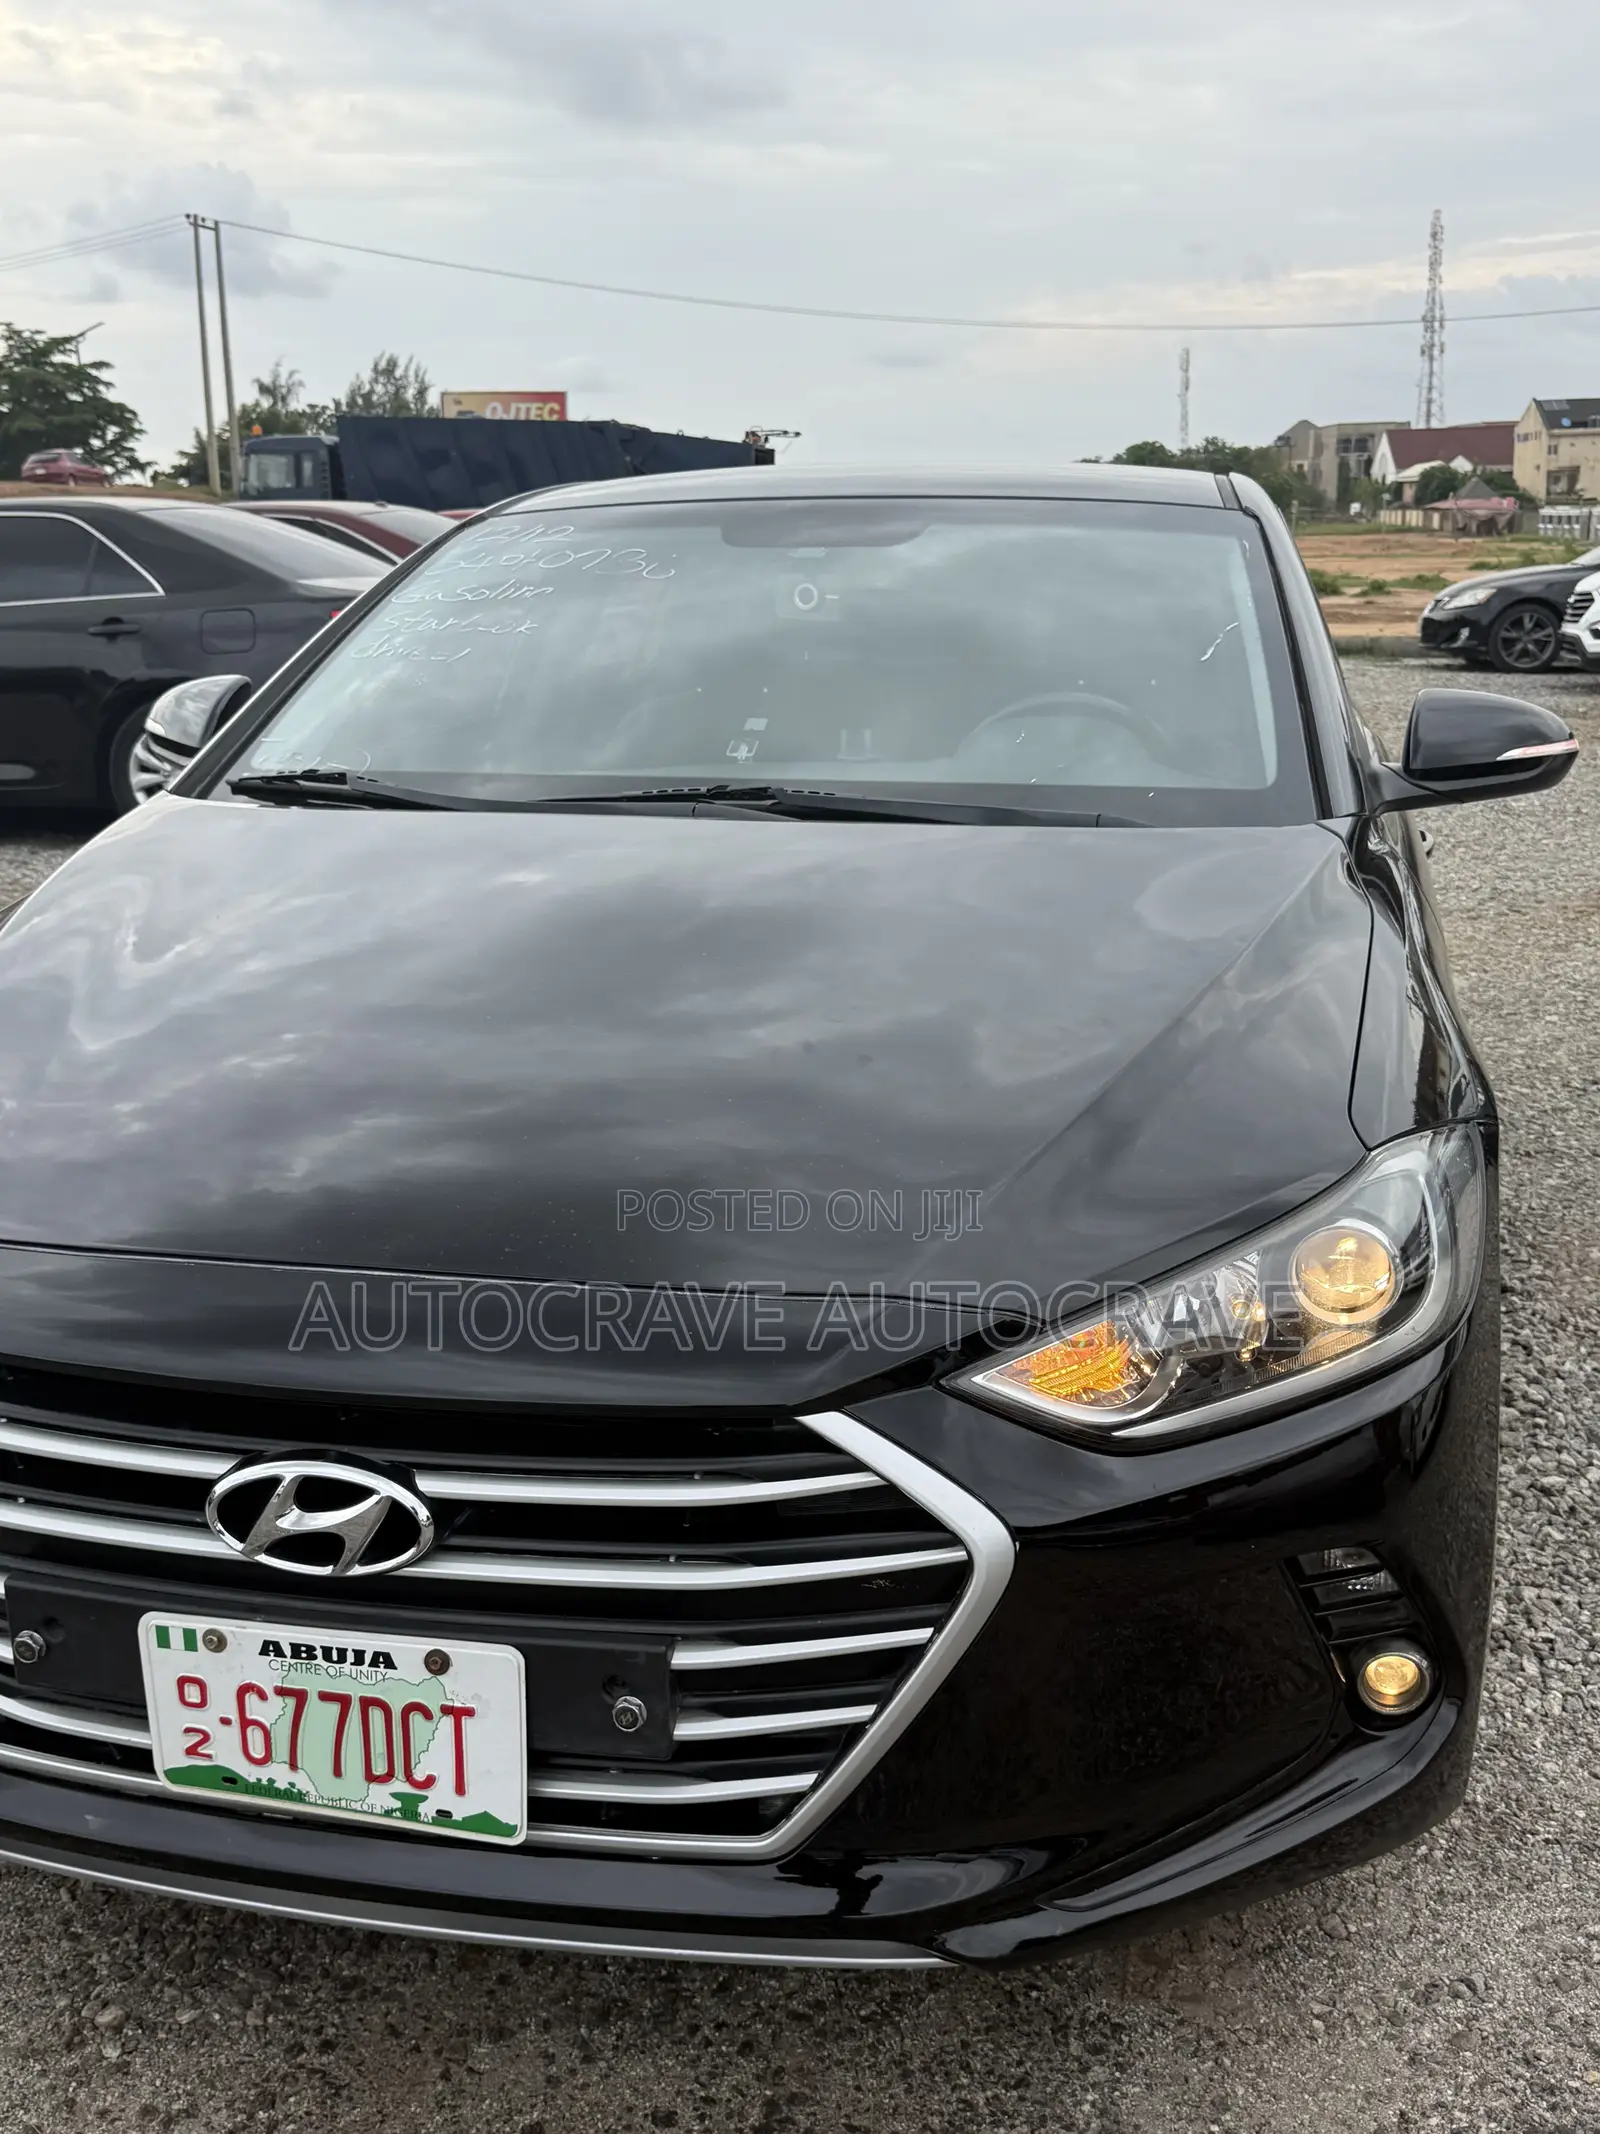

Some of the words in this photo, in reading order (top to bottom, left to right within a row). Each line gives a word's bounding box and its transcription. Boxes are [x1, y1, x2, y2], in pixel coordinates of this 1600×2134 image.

[258, 1638, 398, 1670] ABUJA
[268, 1658, 323, 1677] CENTRE
[325, 1664, 347, 1679] OF
[348, 1667, 388, 1683] UNITY
